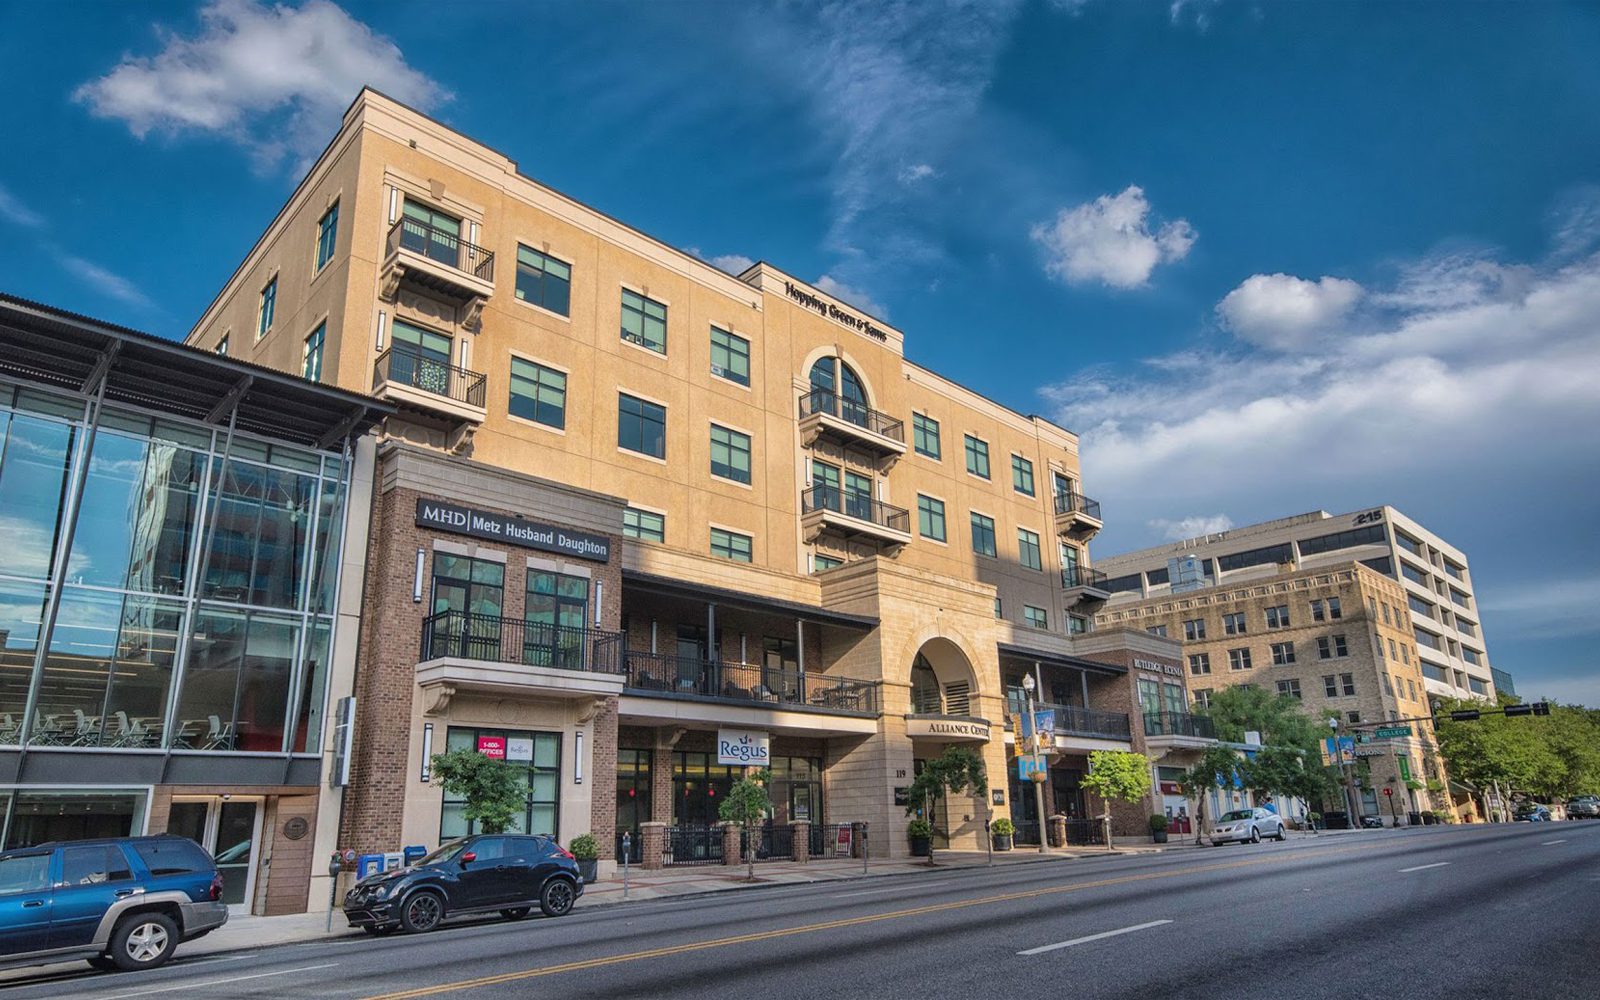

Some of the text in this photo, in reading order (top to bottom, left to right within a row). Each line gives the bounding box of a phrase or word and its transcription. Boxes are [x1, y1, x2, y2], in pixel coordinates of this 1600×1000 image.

[784, 281, 827, 316] Hopping
[828, 304, 856, 328] Green
[856, 319, 864, 331] &
[1357, 510, 1382, 524] 215
[422, 505, 607, 555] MHD Metz Husband Daughton
[928, 723, 970, 735] ALLIANCE
[720, 740, 767, 761] Regus
[895, 769, 906, 778] 119
